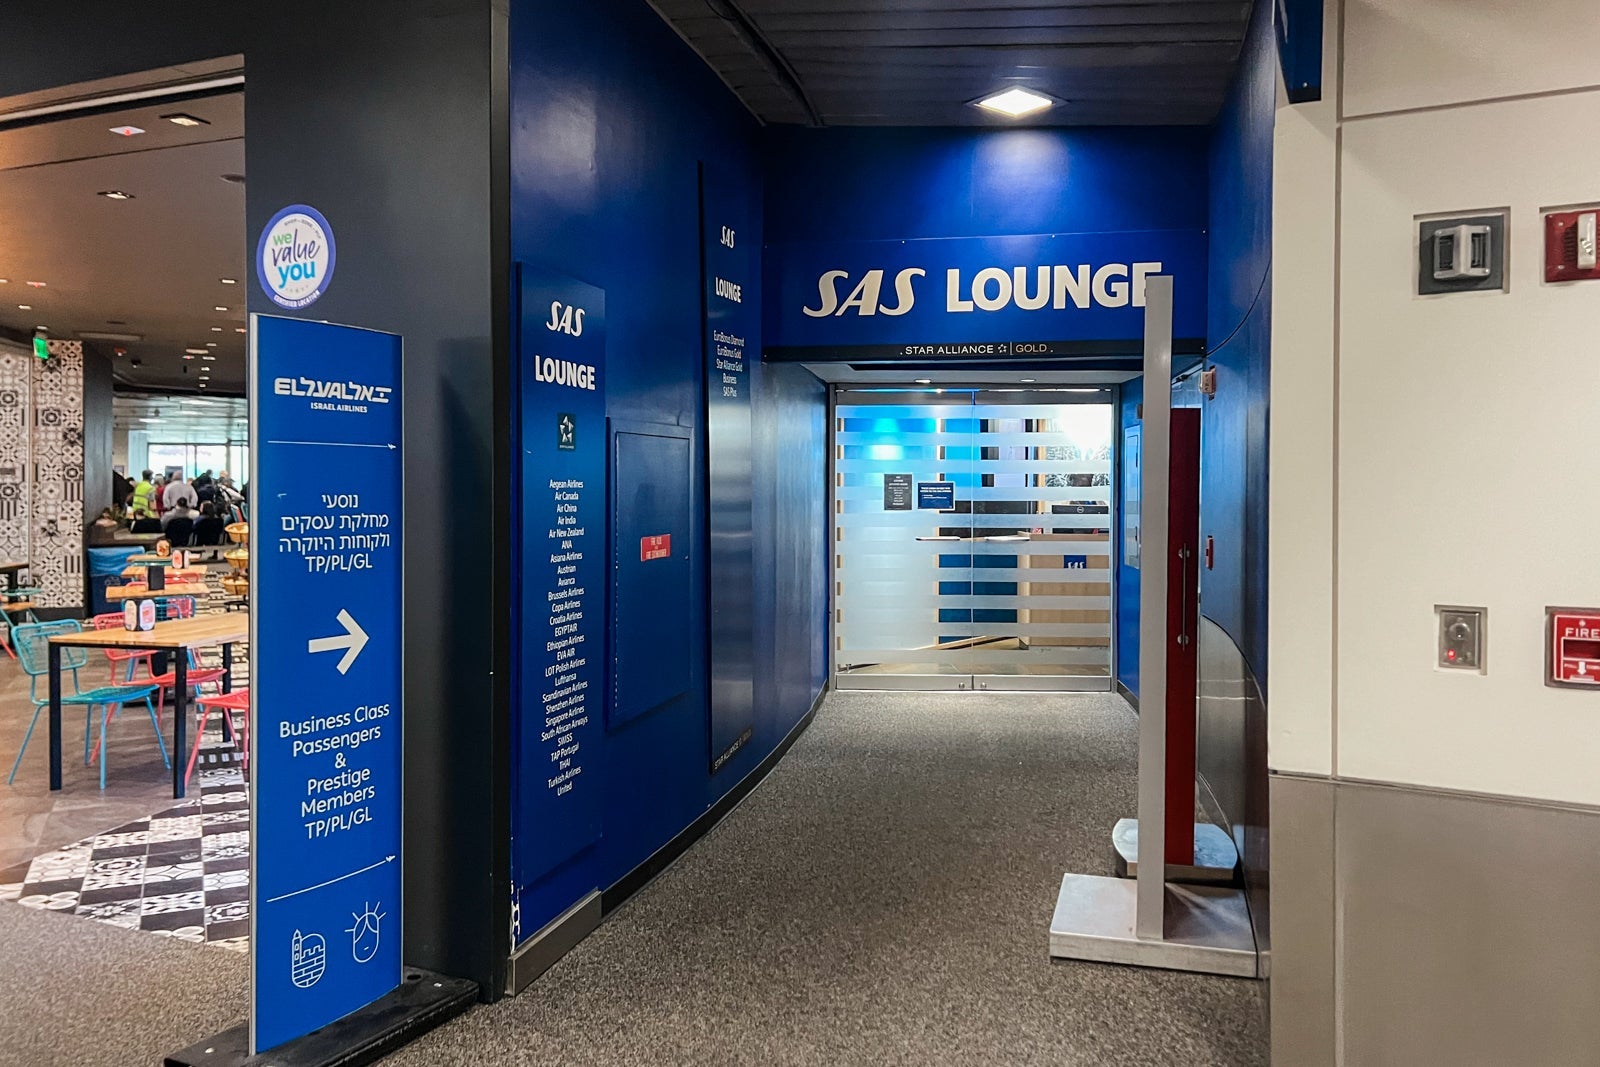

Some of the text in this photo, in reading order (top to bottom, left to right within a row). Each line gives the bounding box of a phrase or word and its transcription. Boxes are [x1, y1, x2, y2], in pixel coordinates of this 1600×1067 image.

[273, 233, 292, 246] we
[720, 226, 735, 248] SAS
[272, 229, 320, 266] value
[278, 262, 315, 288] you
[716, 277, 741, 303] LOUNGE
[803, 268, 925, 317] SAS
[546, 301, 585, 337] SAS
[905, 344, 1047, 355] STAR ALLIANCE GOLD
[535, 355, 596, 390] LOUNGE
[311, 402, 367, 413] ISRAEL AIRLINES
[550, 479, 583, 490] Aegean Airlines
[321, 494, 358, 508] נוסעי
[562, 492, 578, 500] Canada
[564, 504, 577, 512] China
[281, 513, 389, 534] מחלקת עסקים
[565, 516, 576, 524] India
[557, 529, 567, 537] New
[567, 528, 584, 537] Zealand
[280, 533, 390, 555] ולקוחות היוקרה
[562, 540, 572, 549] ANA
[305, 553, 373, 574] TP/PL/GL
[550, 552, 582, 563] Asiana Airlines
[557, 565, 576, 574] Austrian
[548, 587, 584, 601] Brussels Airlines
[552, 600, 580, 613] Copa Airlines
[550, 612, 582, 625] Croatia Airlines
[555, 623, 577, 637] EGYPTAIR
[1565, 627, 1600, 639] FIRE
[547, 635, 584, 651] Ethiopian Airlines
[557, 648, 575, 661] EVA AIR
[545, 658, 585, 677] LOT Polish Airlines
[555, 673, 576, 686] Lufthansa
[542, 681, 588, 703] Scandinavian Airlines
[546, 694, 584, 714] Shenzhen Airlines
[280, 704, 390, 738] Business Class
[546, 706, 584, 727] Singapore Airlines
[541, 716, 588, 741] South African Airways
[293, 726, 381, 757] Passengers
[558, 733, 572, 746] SWISS
[551, 741, 579, 762] TAP Portugal
[335, 752, 346, 769] &
[559, 758, 570, 770] THAI
[308, 768, 370, 796] Prestige
[548, 766, 581, 788] Turkish Airlines
[557, 781, 572, 796] United
[302, 786, 375, 817] Members
[305, 806, 372, 839] TP/PL/GL
